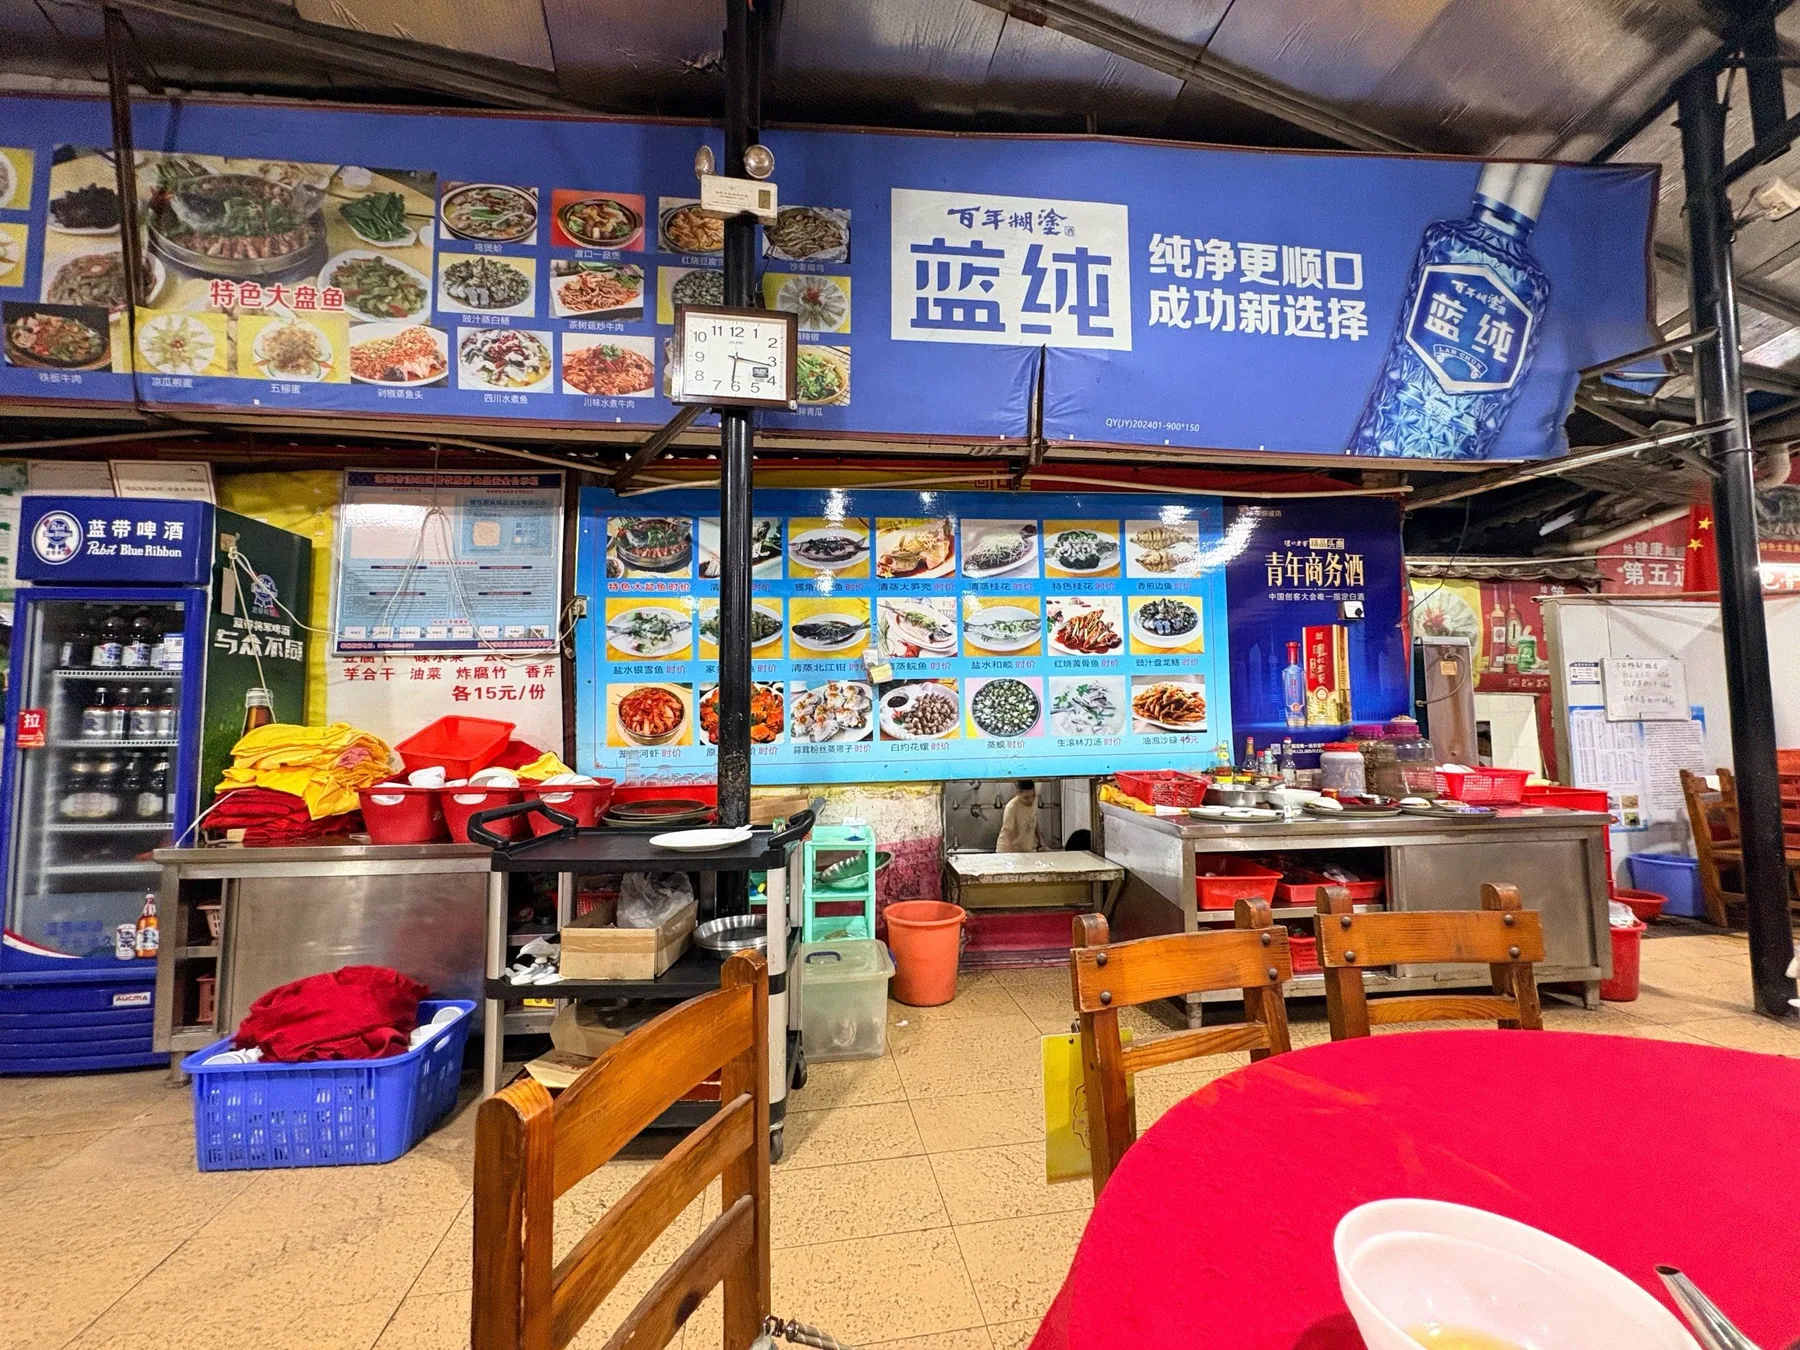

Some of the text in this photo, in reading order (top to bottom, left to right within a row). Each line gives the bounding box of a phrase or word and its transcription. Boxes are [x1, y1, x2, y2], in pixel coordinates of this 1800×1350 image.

[1149, 233, 1363, 290] 纯净更顺口
[911, 237, 1114, 338] 蓝纯
[210, 280, 345, 312] 特色大盘鱼
[1149, 285, 1368, 341] 成功新选择
[569, 320, 624, 332] 茶树菇炒牛肉
[712, 325, 723, 336] 11
[1424, 293, 1514, 363] 蓝纯
[693, 332, 707, 343] 10
[730, 327, 745, 338] 12
[753, 328, 759, 338] 1
[768, 338, 778, 348] 2
[694, 351, 705, 362] 9
[768, 356, 778, 367] 3
[694, 370, 705, 381] 8
[767, 376, 777, 386] 4
[713, 380, 723, 390] 7
[731, 381, 741, 392] 6
[751, 382, 760, 393] 5
[378, 389, 423, 400] 剁椒蒸鱼头
[484, 393, 528, 405] 四川水煮鱼
[584, 397, 635, 410] 川味水煮牛肉
[87, 519, 185, 541] 蓝带啤酒
[87, 541, 183, 558] Pabst Blue Ribbon
[1265, 551, 1364, 587] 青年商务酒
[668, 582, 691, 592] 时价
[846, 583, 863, 592] 时价
[878, 582, 955, 592] 清蒸大笋壳 时价
[1013, 583, 1033, 591] 时价
[1052, 582, 1115, 591] 特色桂花 时价
[1268, 592, 1365, 601] 中国创客大会唯一指定白酒
[214, 628, 303, 662] 与众不同
[931, 662, 951, 671] 时价
[971, 660, 1036, 670] 盐水和顺 时价
[1054, 659, 1119, 668] 红烧黄骨鱼 时价
[1182, 658, 1199, 667] 时价
[410, 667, 441, 680] 油菜
[456, 665, 507, 680] 炸腐竹
[525, 664, 556, 679] 香芹
[613, 665, 686, 675] 盐水银雪鱼 时价
[758, 664, 777, 673] 时价
[452, 684, 546, 702] 各15元/份
[24, 713, 41, 729] 拉
[855, 744, 871, 753] 时价
[891, 742, 949, 752] 白灼花螺 时价
[1008, 740, 1025, 749] 时价
[1056, 738, 1121, 748] 生滚林刀汤 时价
[662, 748, 681, 757] 时价
[759, 746, 778, 755] 时价
